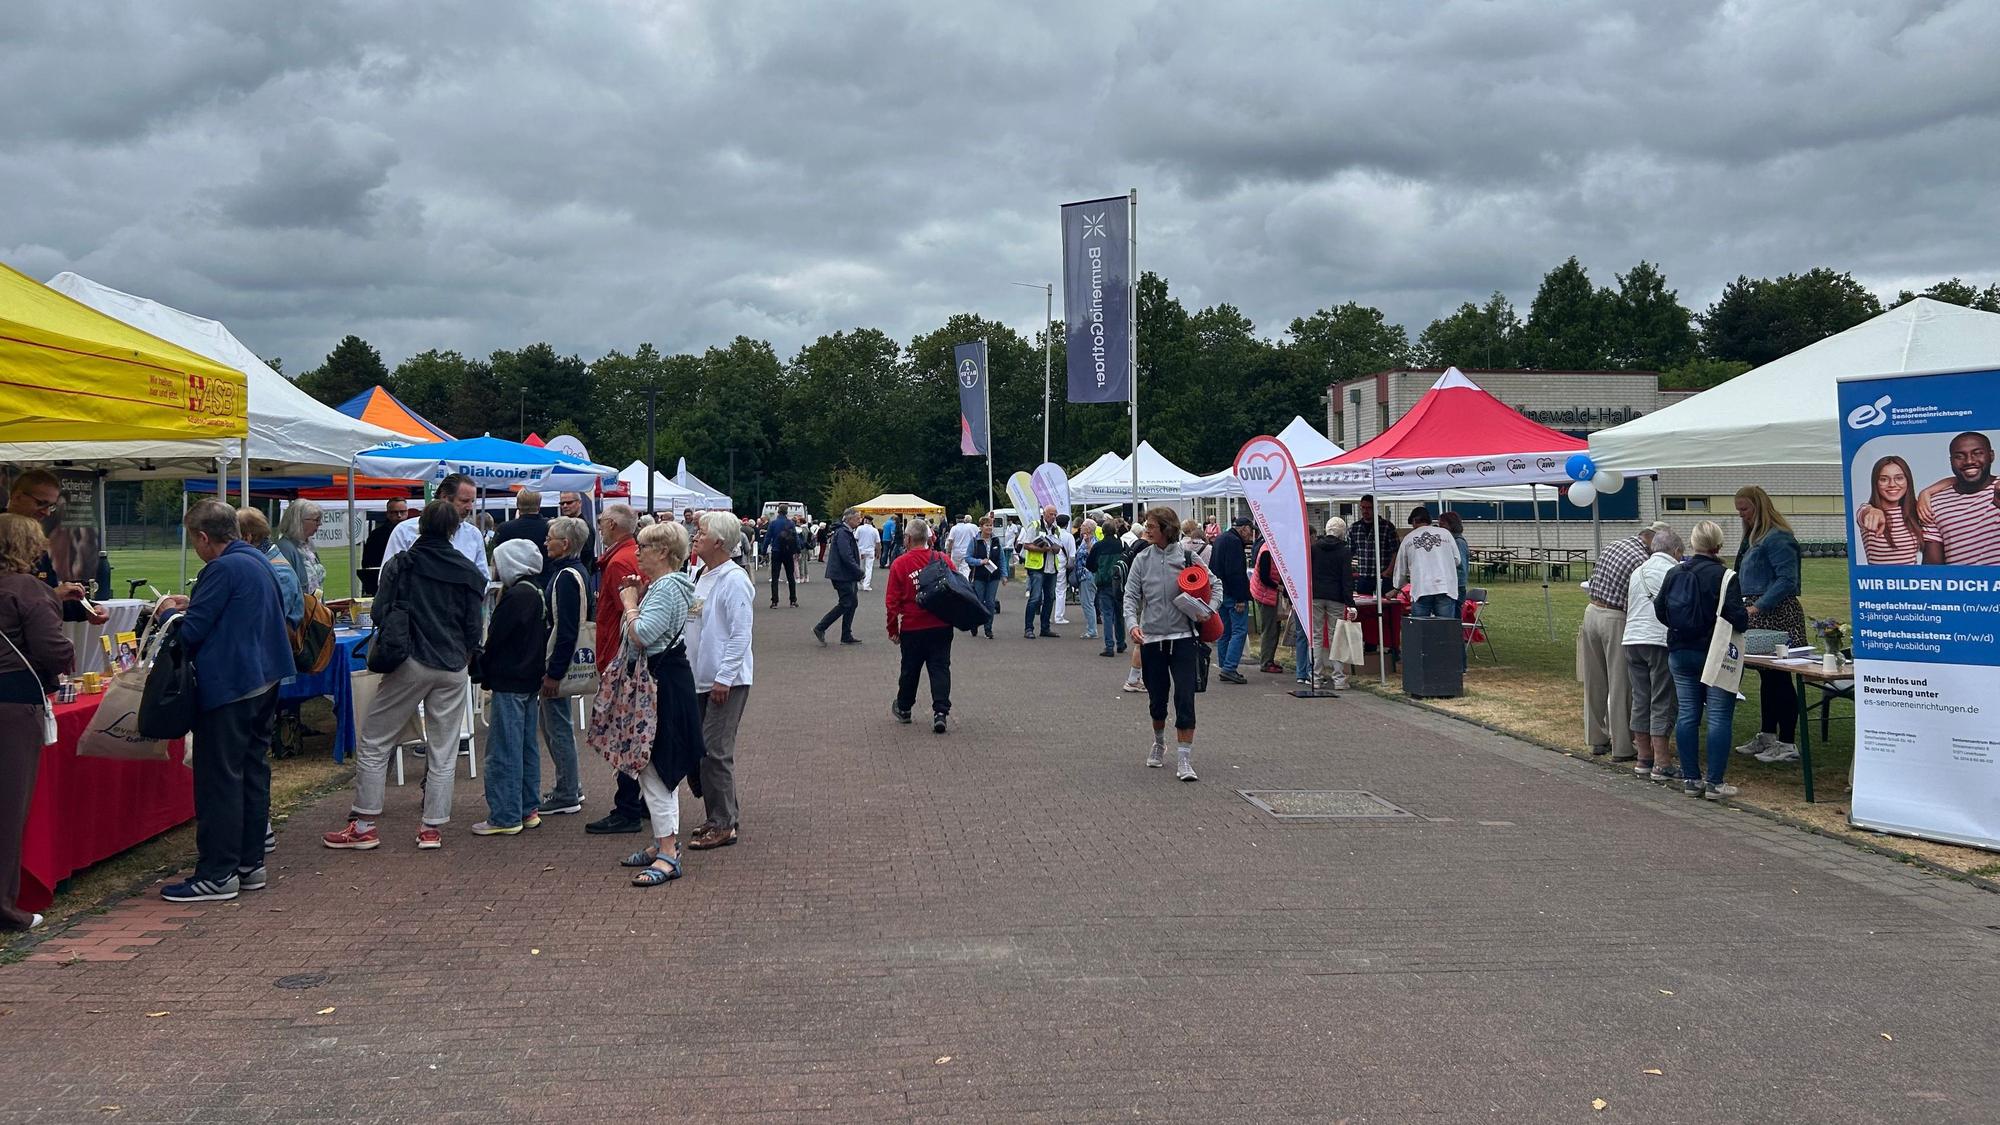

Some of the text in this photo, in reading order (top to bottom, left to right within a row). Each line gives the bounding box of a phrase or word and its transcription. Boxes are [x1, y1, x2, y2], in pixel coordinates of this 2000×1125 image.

[202, 377, 235, 416] ASB
[1892, 405, 1938, 414] Evangelische
[1892, 409, 1973, 420] Senioreneinrichtungen
[1892, 418, 1928, 426] Leverkusen
[459, 465, 528, 479] Diakonie
[1091, 486, 1105, 494] Wir
[1138, 486, 1178, 494] Menschen
[1857, 579, 1884, 590] WIR
[1887, 579, 1942, 591] BILDEN
[1946, 580, 1989, 592] DICH
[1859, 601, 1960, 612] Pflegefachfrau/-mann
[1859, 612, 1942, 624] 3-jährige Ausbildung
[1860, 629, 1994, 644] Pflegefachassistenz (m/w/d)
[1862, 640, 1941, 653] 1-jährige Ausbildung
[568, 671, 597, 680] bewegt
[1863, 675, 1927, 687] Mehr Infos und
[1863, 686, 1939, 699] Bewerbung unter
[1863, 699, 1980, 714] es-senioreneinrichtungen.de
